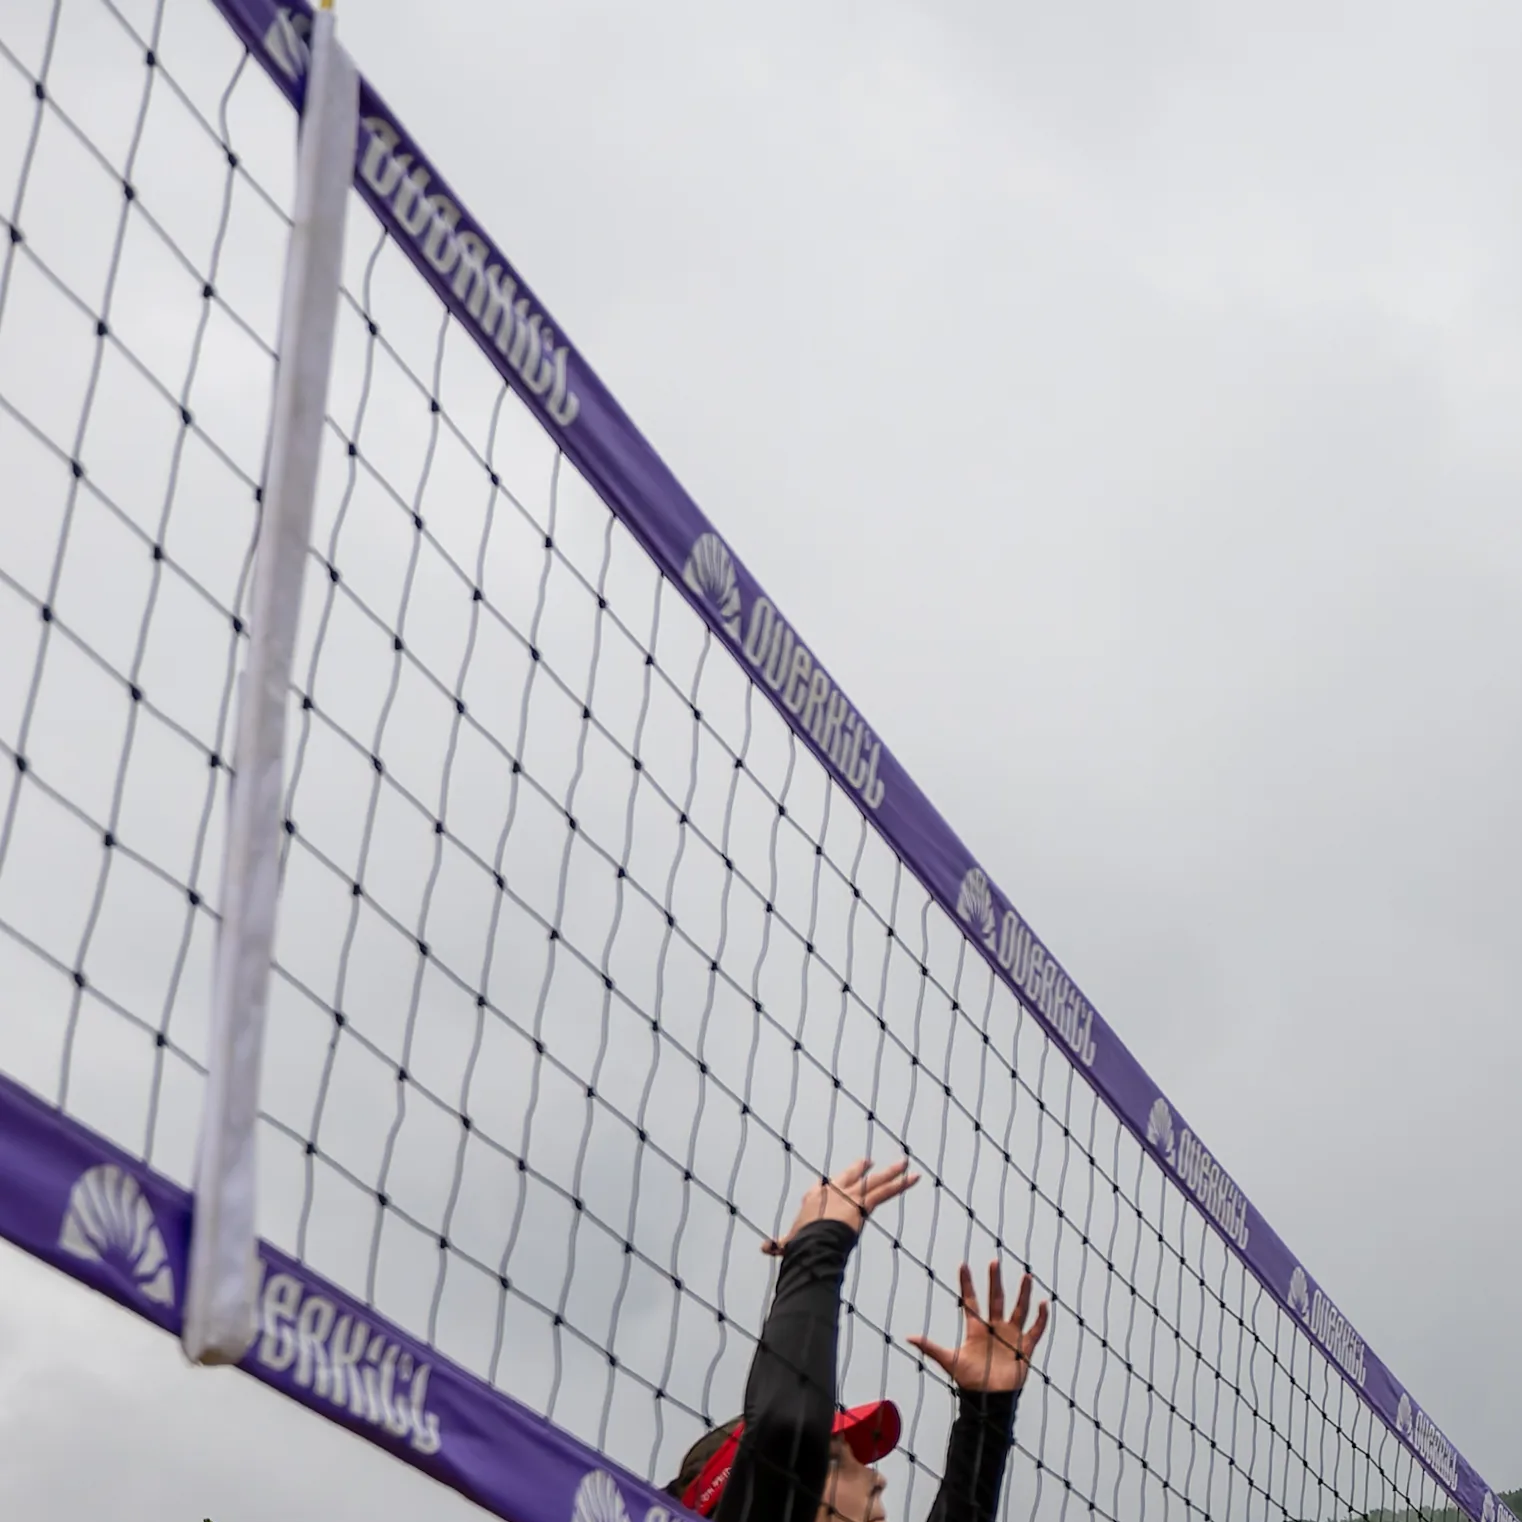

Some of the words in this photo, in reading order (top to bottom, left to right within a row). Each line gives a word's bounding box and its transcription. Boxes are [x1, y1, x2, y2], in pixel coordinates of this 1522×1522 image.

[745, 596, 885, 809] OVERKILL
[997, 910, 1097, 1067] OVERKILL
[1177, 1128, 1249, 1250] OVERKILL
[1309, 1288, 1367, 1387] OVERKILL
